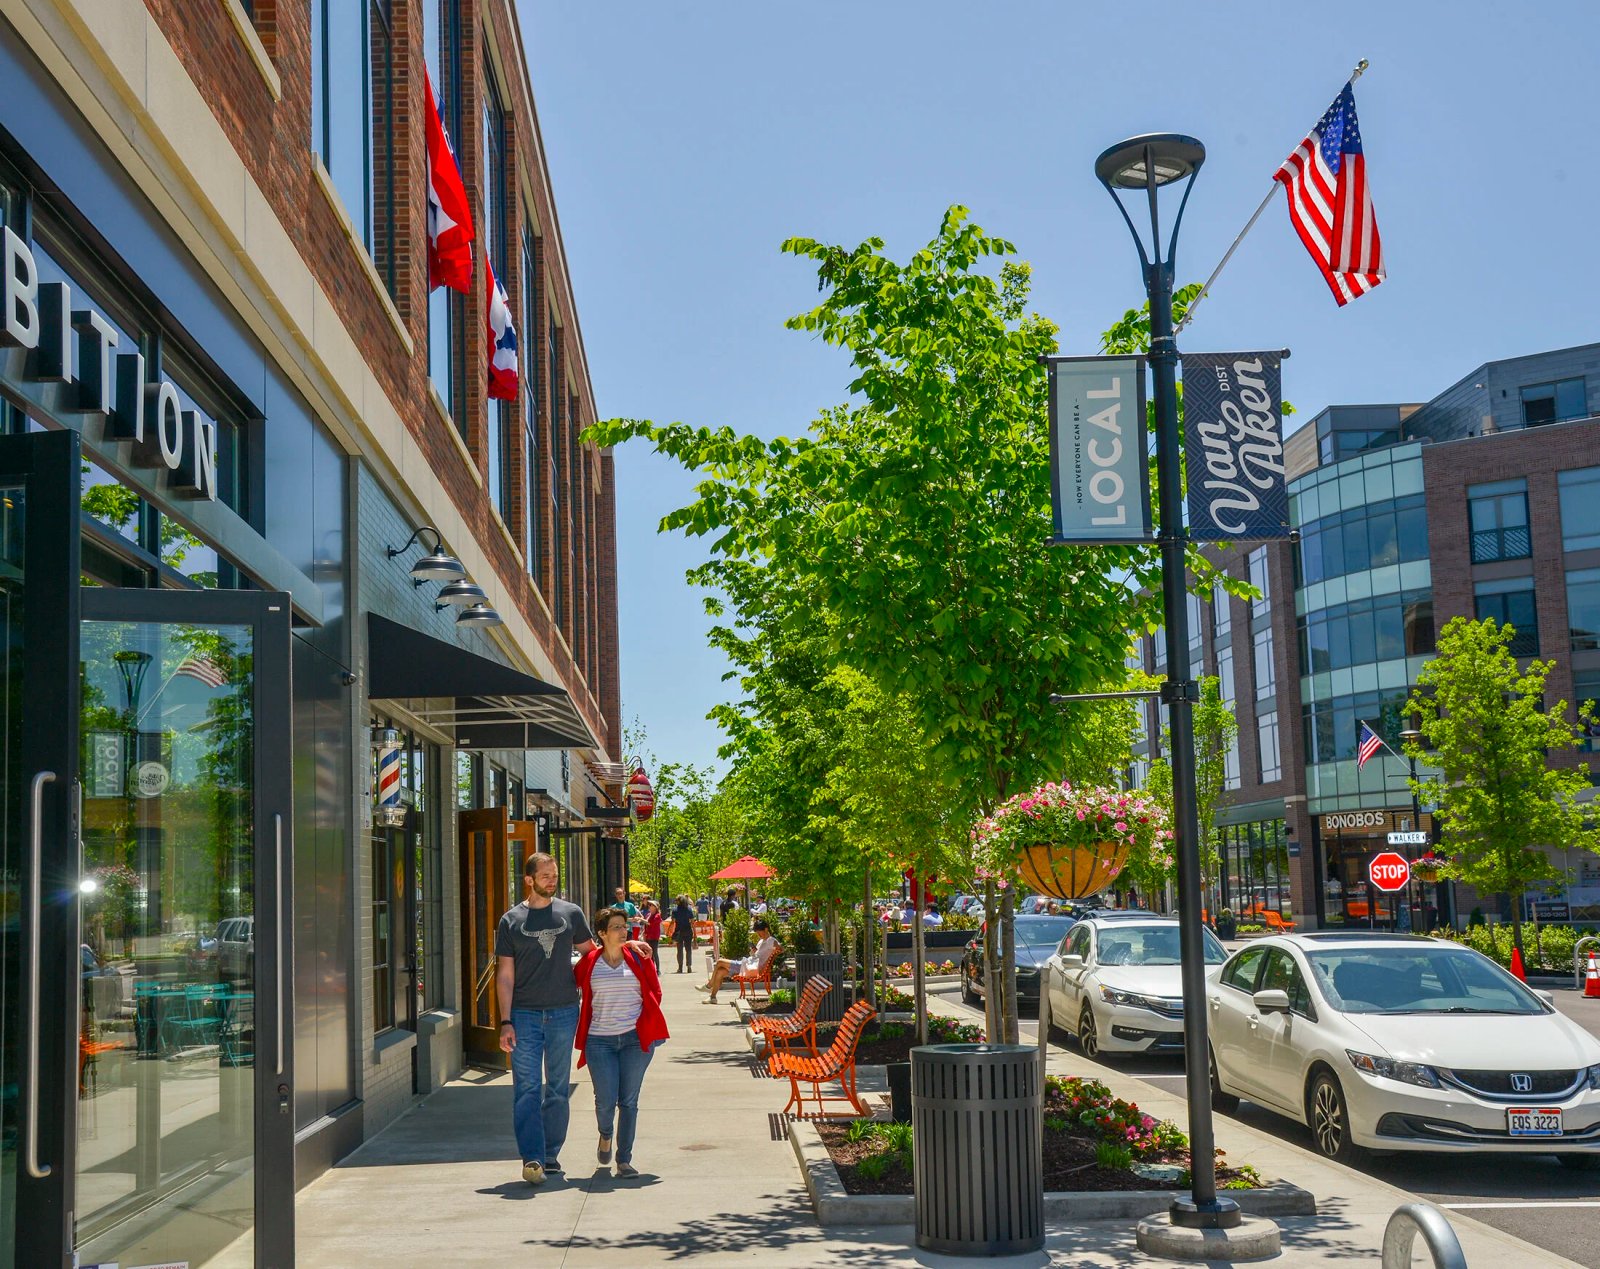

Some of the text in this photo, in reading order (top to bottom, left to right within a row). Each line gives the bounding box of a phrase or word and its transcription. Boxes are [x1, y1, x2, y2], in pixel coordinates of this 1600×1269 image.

[4, 225, 216, 502] BITION
[1215, 364, 1231, 392] DIST
[1073, 412, 1080, 422] BE
[1073, 424, 1081, 440] CAN
[1086, 377, 1127, 526] LOCAL
[1197, 357, 1285, 534] Van Aken
[1074, 442, 1082, 483] EVERYONE
[1326, 811, 1385, 830] BONOBOS
[1393, 833, 1420, 842] WALKER
[1372, 864, 1406, 880] STOP
[1533, 1116, 1559, 1130] 3223
